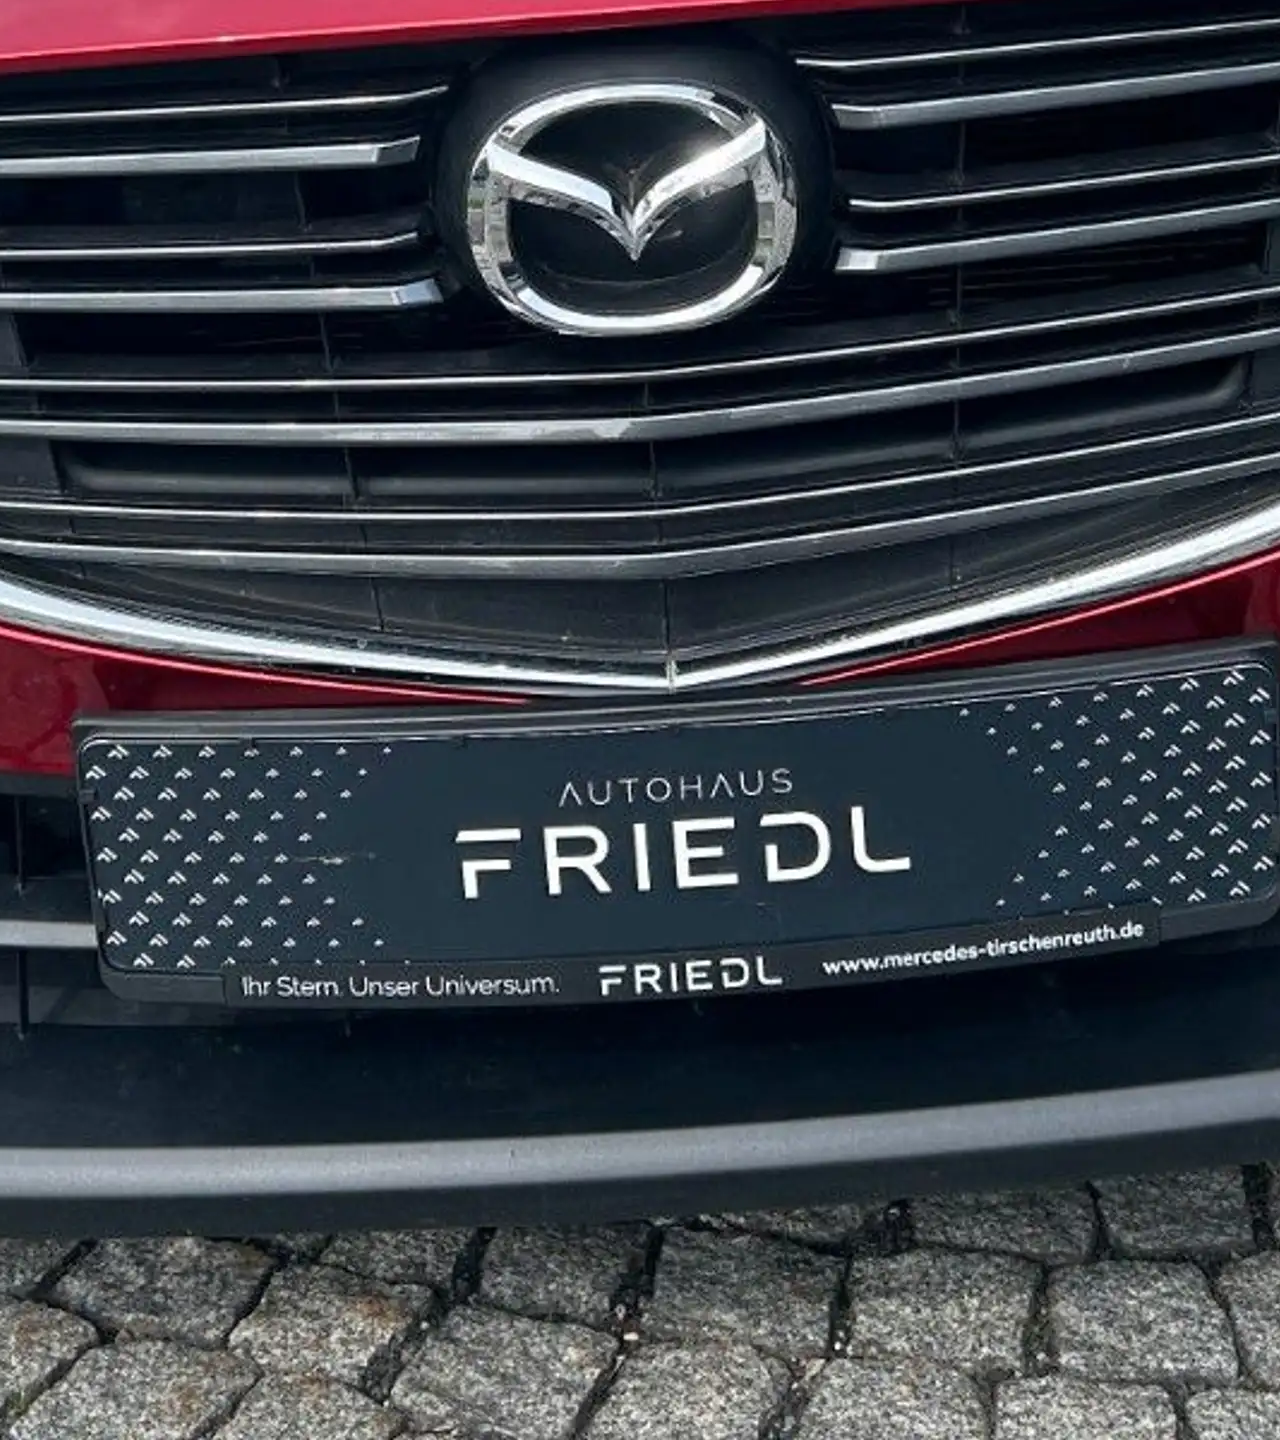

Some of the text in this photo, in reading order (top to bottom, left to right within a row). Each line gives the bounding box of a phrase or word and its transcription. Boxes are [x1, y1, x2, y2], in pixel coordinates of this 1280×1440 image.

[558, 768, 793, 808] AUTOHAUS
[455, 806, 911, 899] FRIEDL
[822, 921, 1145, 976] www.mercedes-tirschenreuth.de
[241, 975, 271, 997] Ihr
[348, 976, 418, 997] Unser
[426, 974, 560, 996] Universum.
[599, 956, 783, 996] FRIEDL
